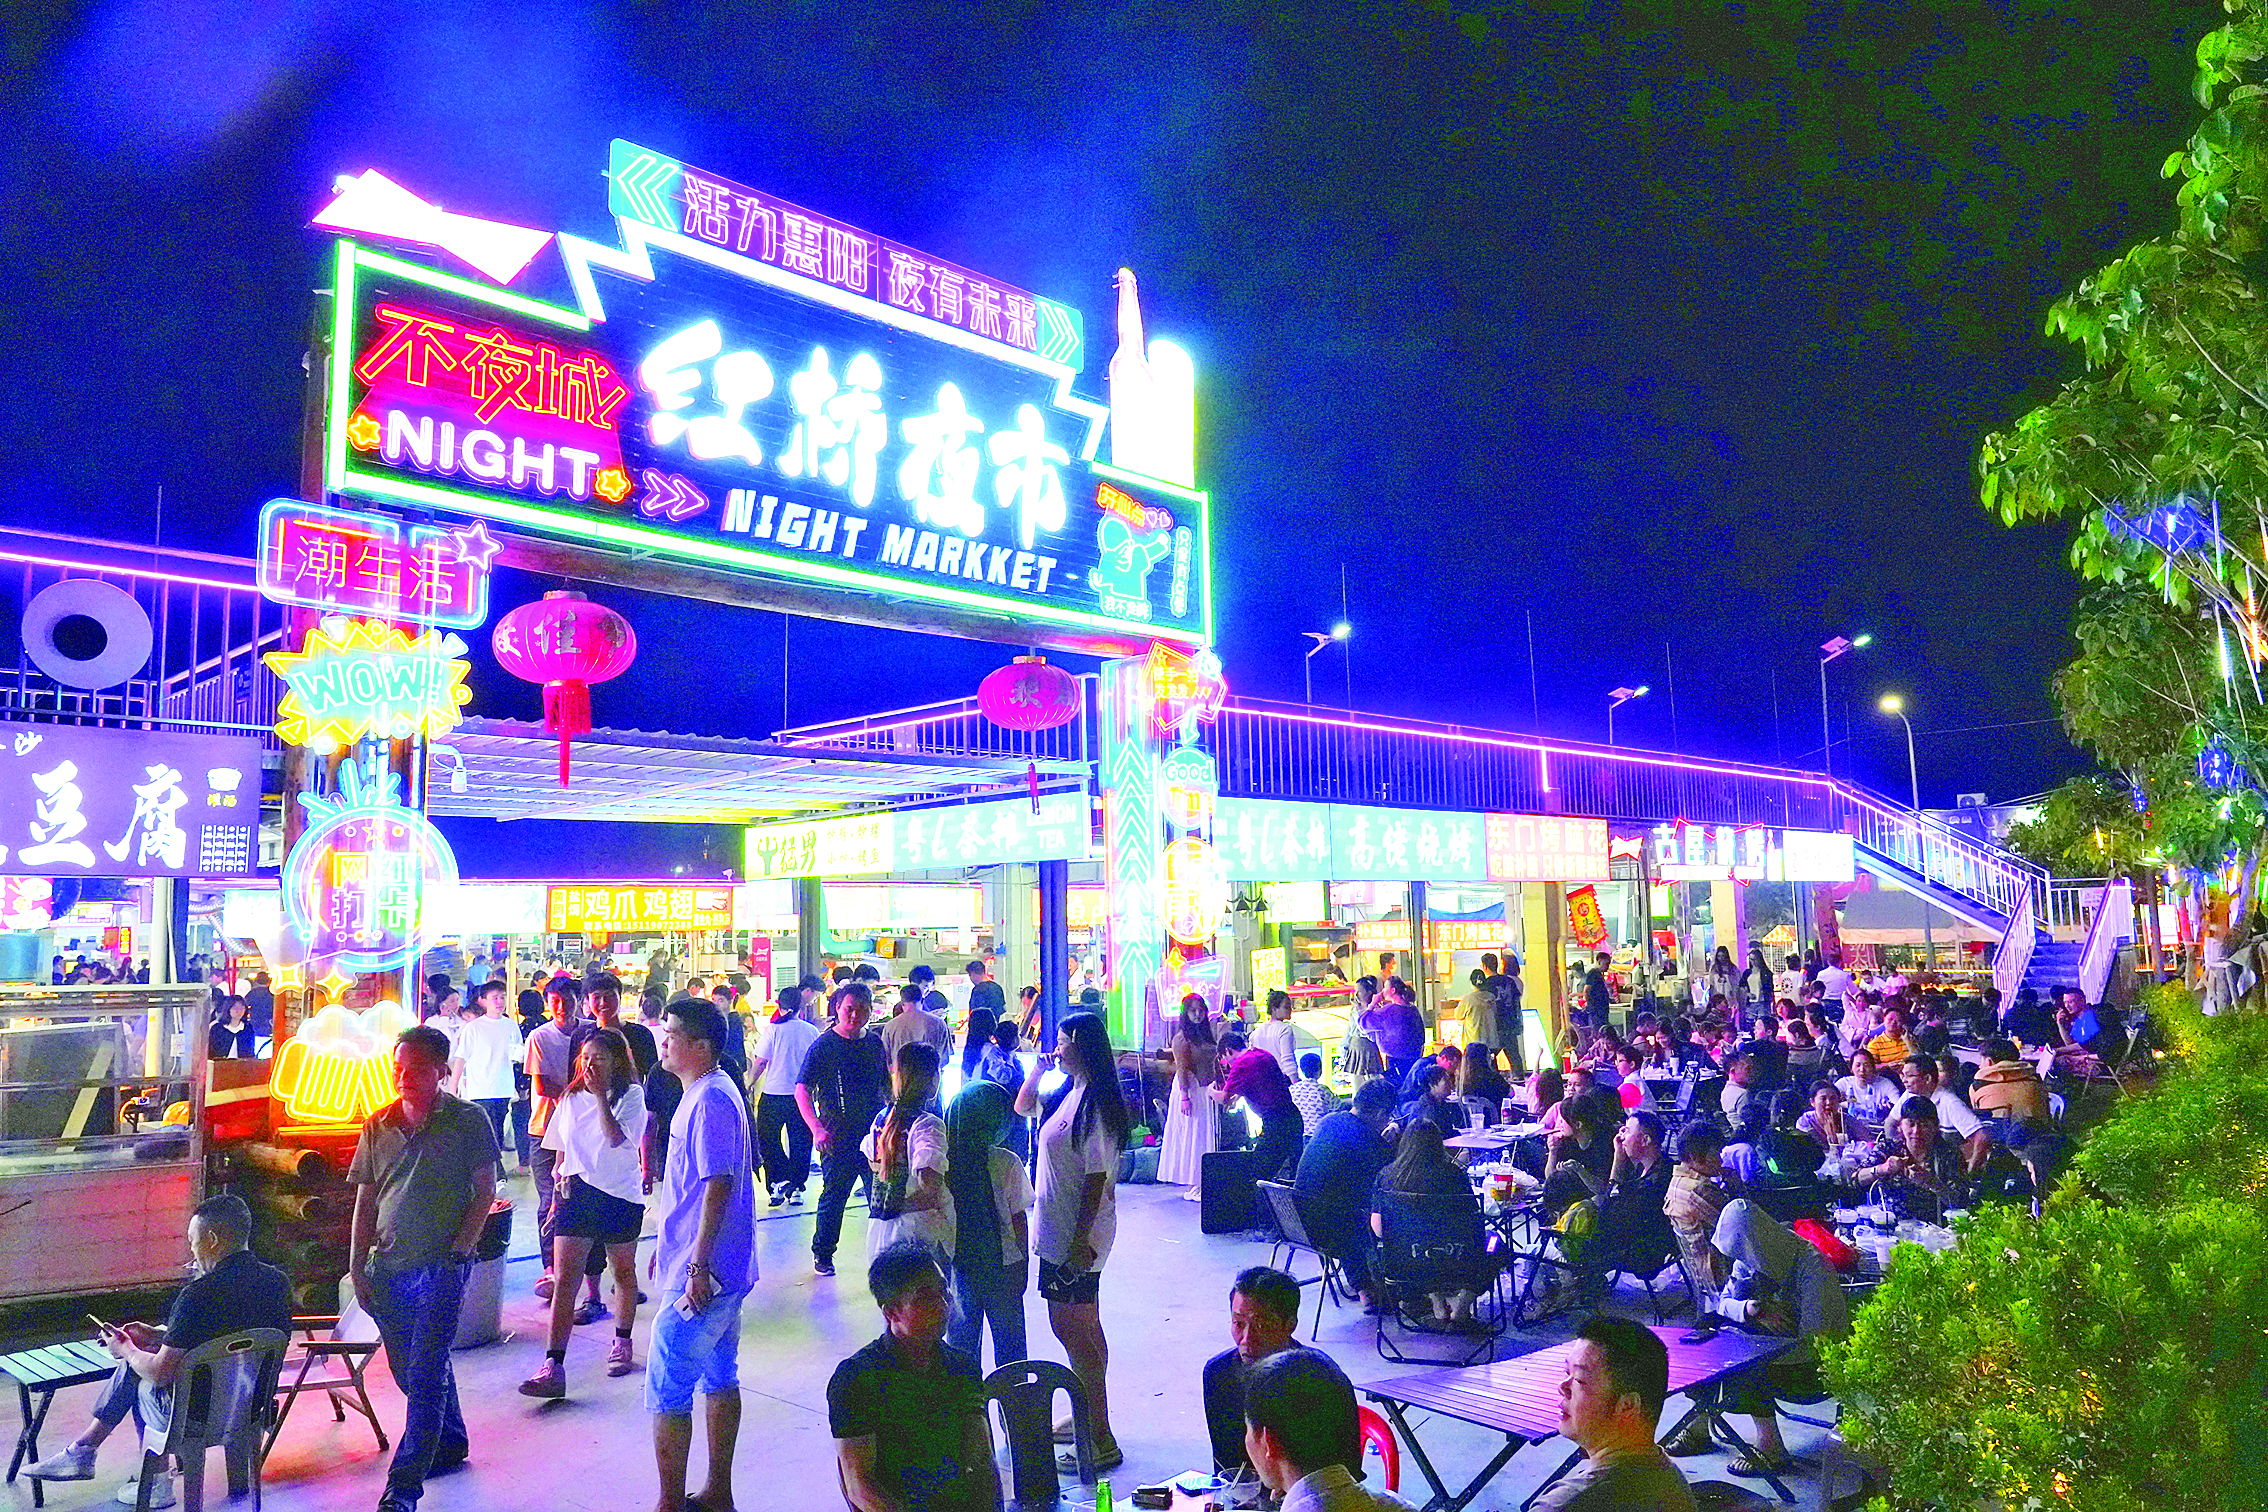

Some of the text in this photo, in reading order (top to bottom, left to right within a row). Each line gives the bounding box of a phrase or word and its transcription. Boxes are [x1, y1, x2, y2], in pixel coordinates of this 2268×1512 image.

[683, 172, 1038, 351] 活力惠阳 夜有未来
[358, 307, 629, 430] 不夜城
[383, 409, 600, 495] NIGHT
[639, 319, 1071, 549] 红桥夜市
[723, 488, 1057, 593] NIGHT MARKKET
[296, 535, 453, 605] 潮生活
[291, 656, 444, 714] WOW!
[1163, 759, 1215, 783] Good
[1026, 803, 1077, 827] LEMON
[1487, 816, 1608, 854] 东门烤脑花
[779, 829, 817, 874] 猛男
[1037, 828, 1066, 849] TEA
[333, 852, 410, 888] 网红
[584, 888, 638, 921] 鸡爪
[643, 888, 693, 920] 鸡翅
[1438, 923, 1504, 941] 东门烤脑花
